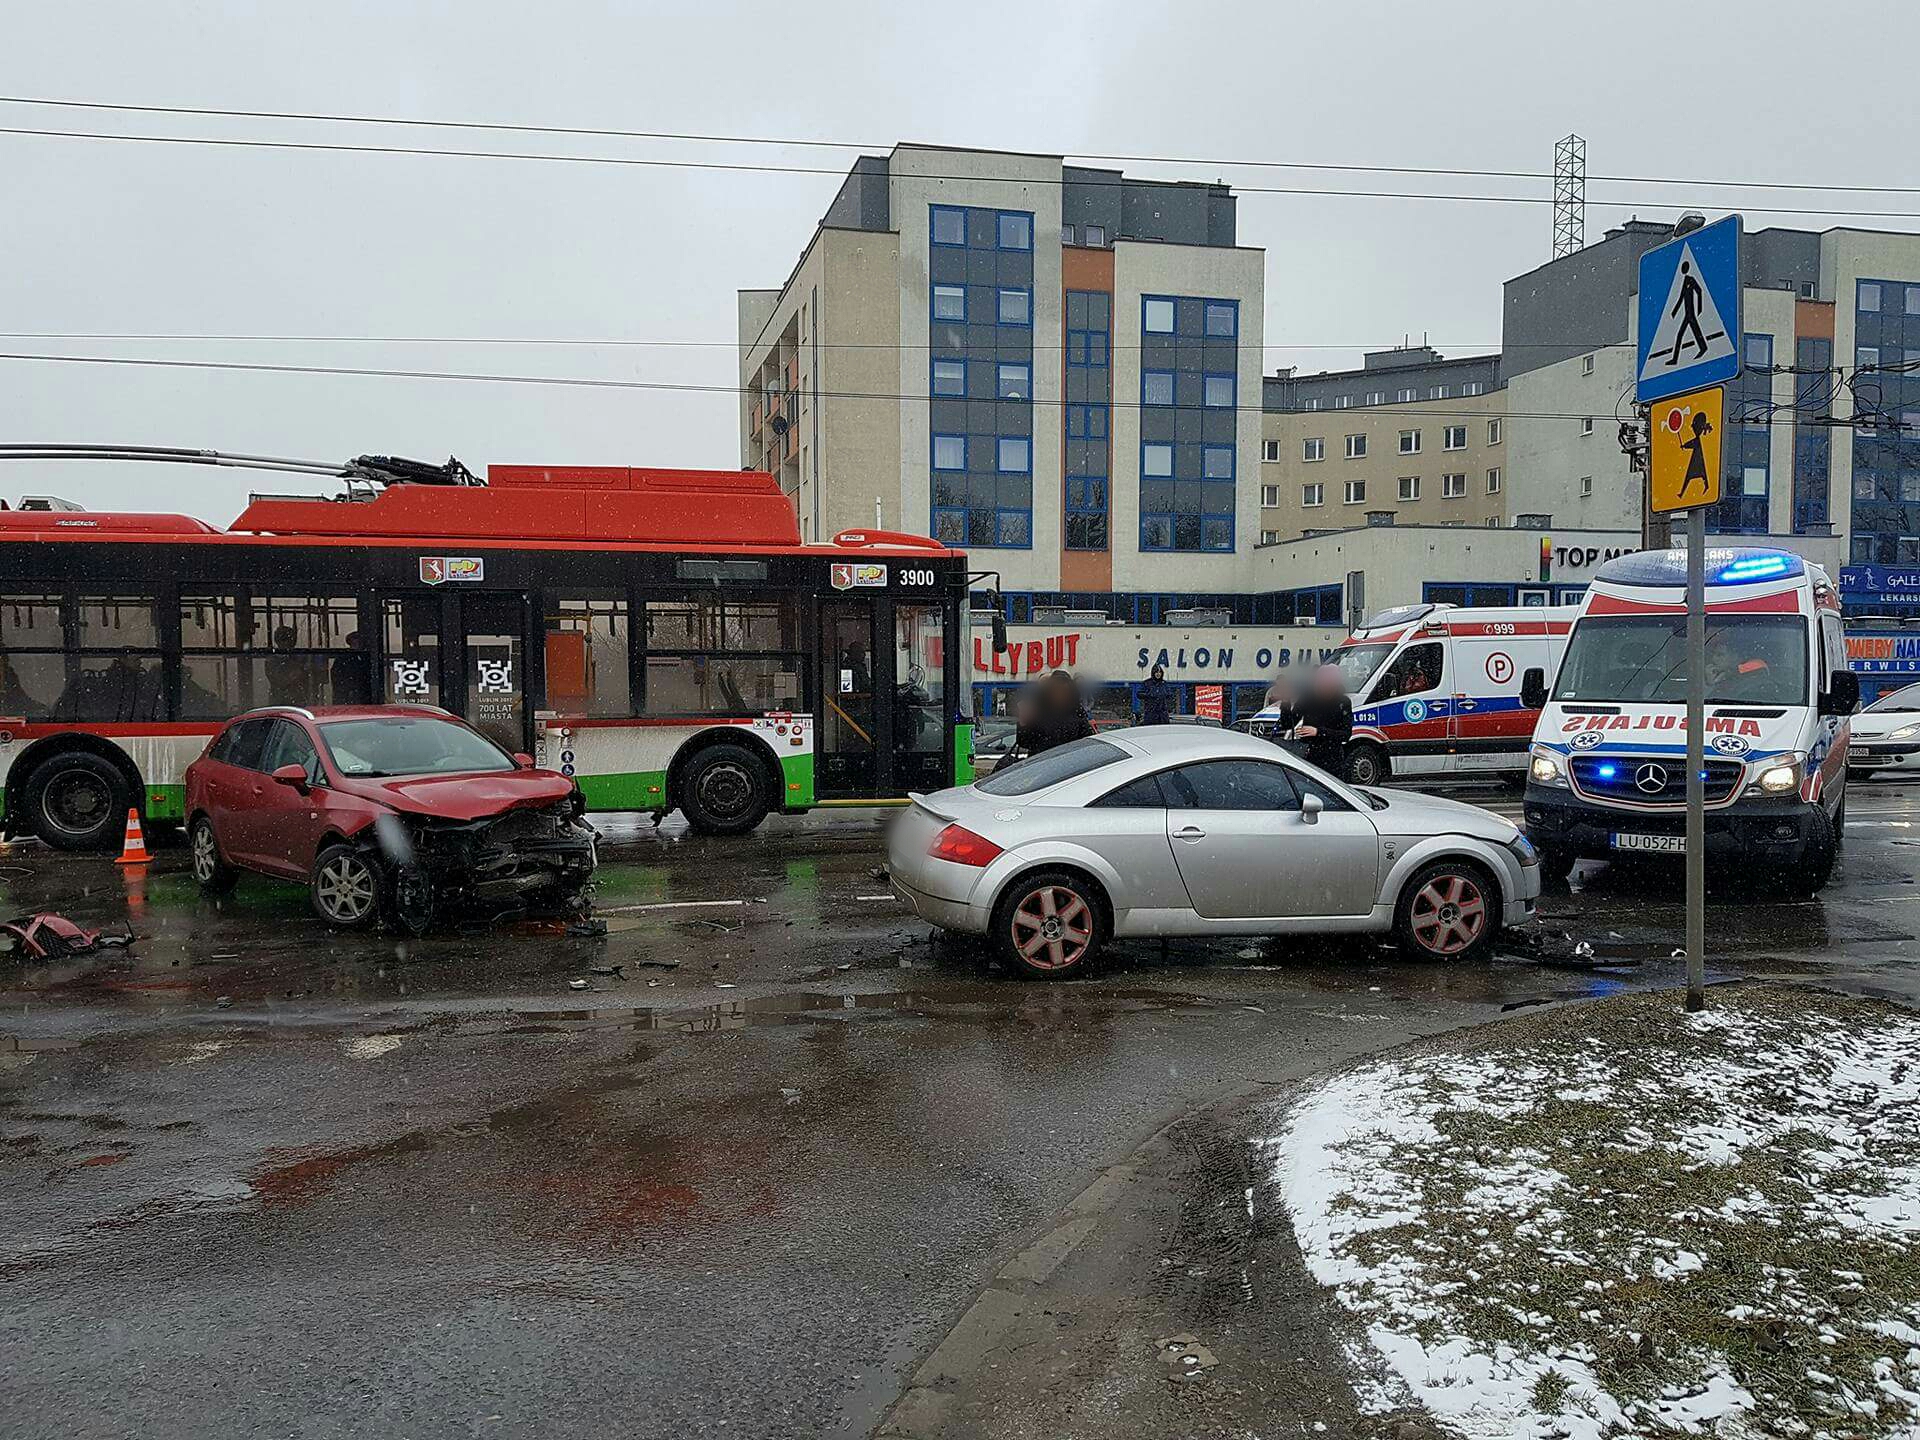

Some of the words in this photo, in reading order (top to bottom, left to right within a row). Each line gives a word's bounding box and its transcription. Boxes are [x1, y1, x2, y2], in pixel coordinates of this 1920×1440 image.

[1556, 546, 1600, 568] TOP
[1667, 549, 1734, 561] AMANS
[899, 569, 935, 586] 3900
[1887, 575, 1920, 587] GALE
[1880, 593, 1920, 602] LEKARS
[1493, 623, 1516, 635] 999
[928, 633, 1081, 675] LLYBUT
[1137, 646, 1234, 670] SALON
[1255, 647, 1338, 669] OBUW
[1494, 660, 1506, 678] P
[1848, 661, 1916, 671] ERWIS
[479, 704, 496, 713] 700
[496, 704, 513, 713] LAT
[1619, 835, 1638, 848] LU
